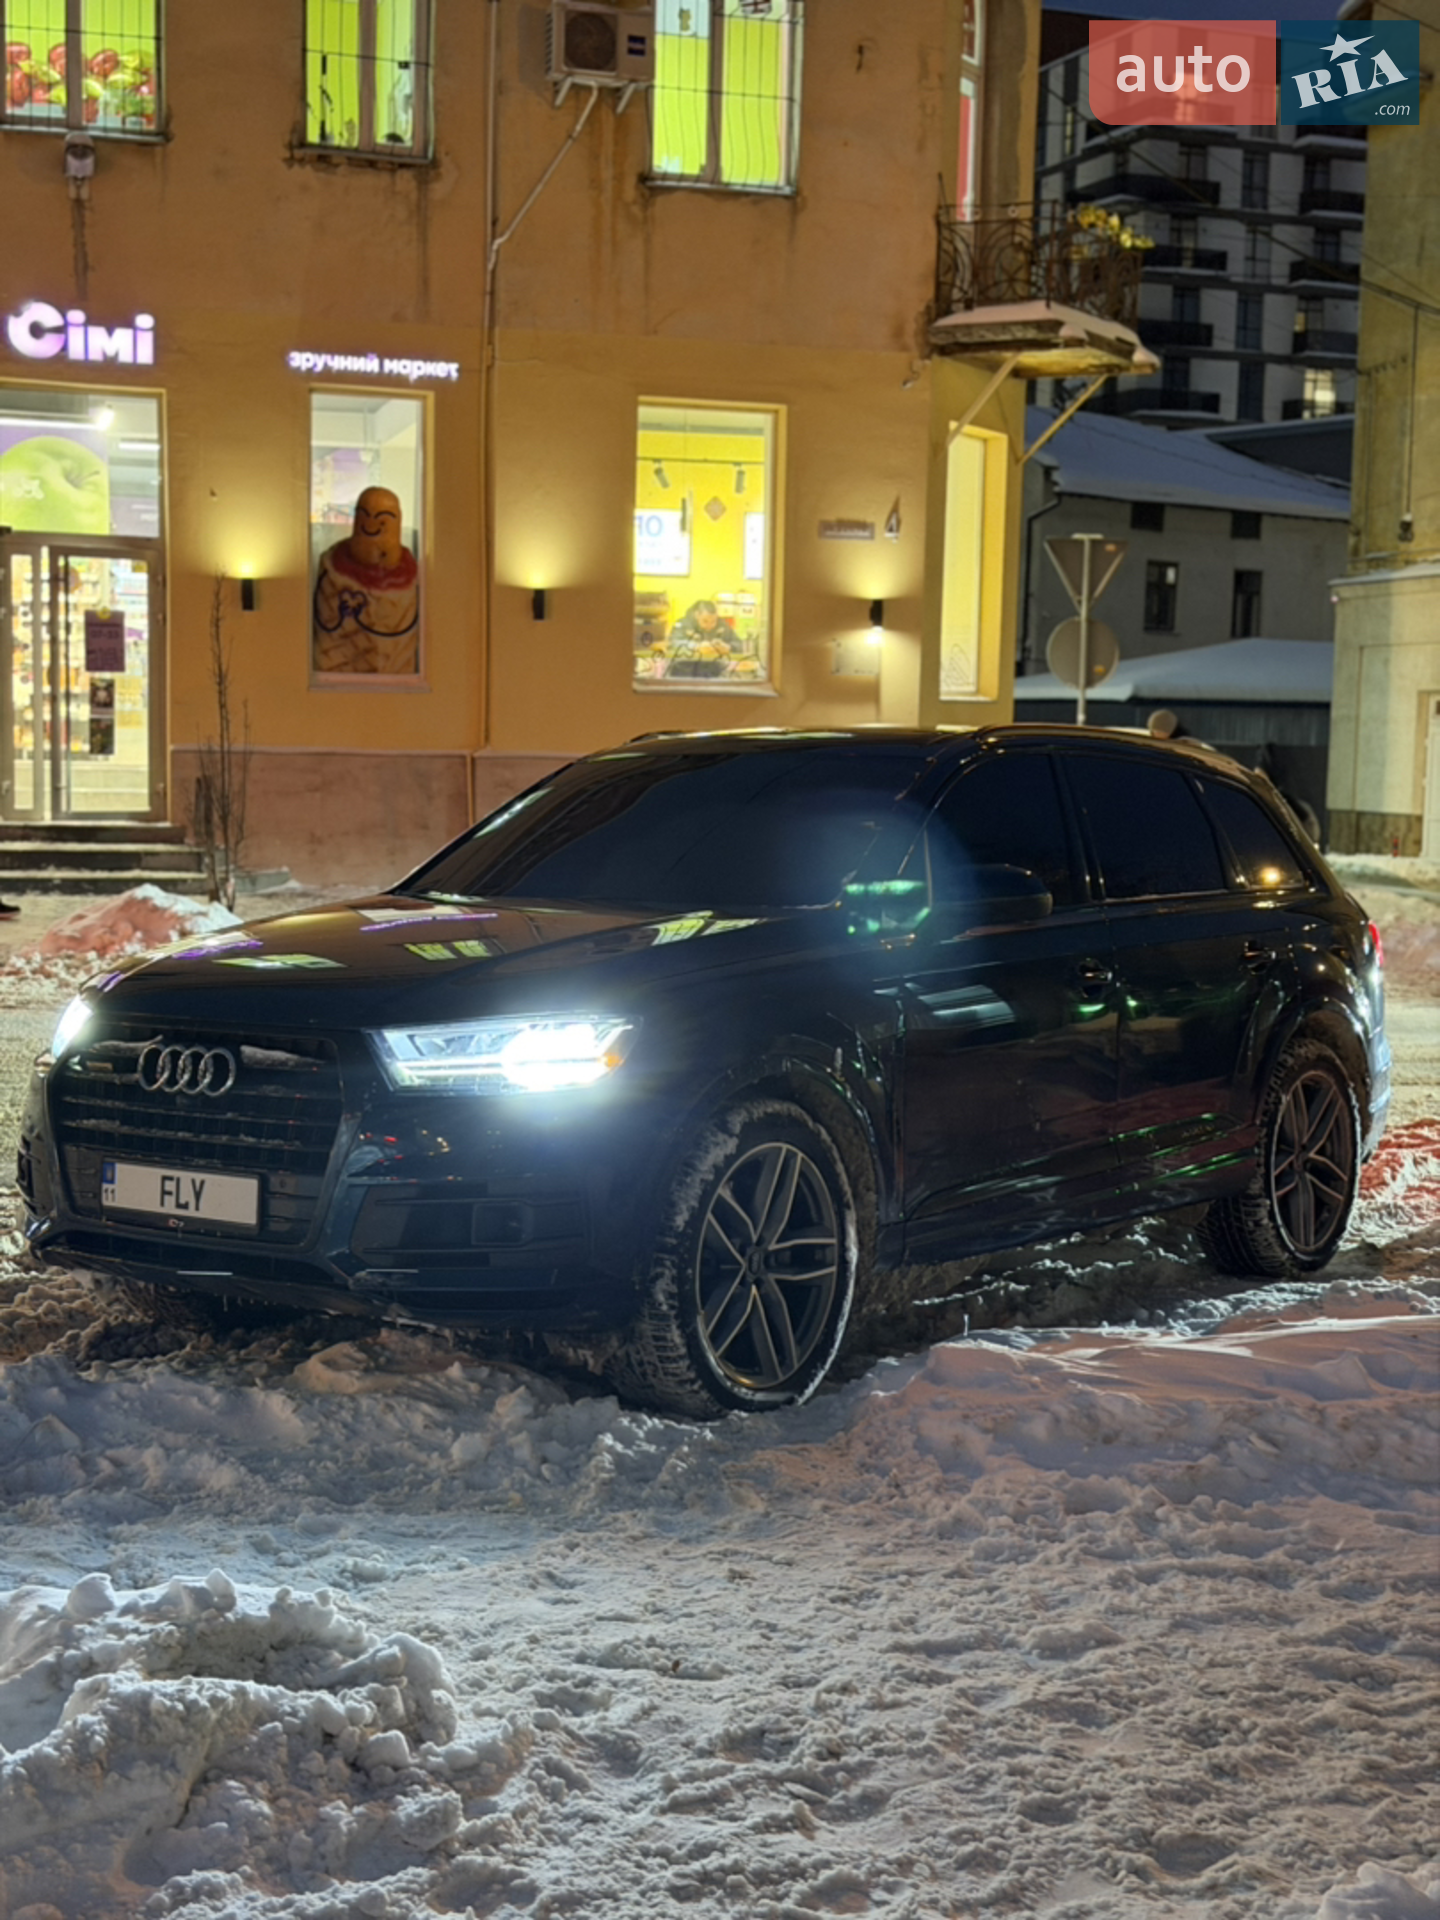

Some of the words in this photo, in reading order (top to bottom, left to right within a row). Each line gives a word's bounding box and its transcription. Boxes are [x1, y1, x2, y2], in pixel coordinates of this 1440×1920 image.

[8, 301, 154, 364] Сімі
[288, 350, 380, 373] зручний
[383, 358, 459, 382] маркет
[104, 1188, 116, 1203] 11
[160, 1175, 205, 1211] FLY
